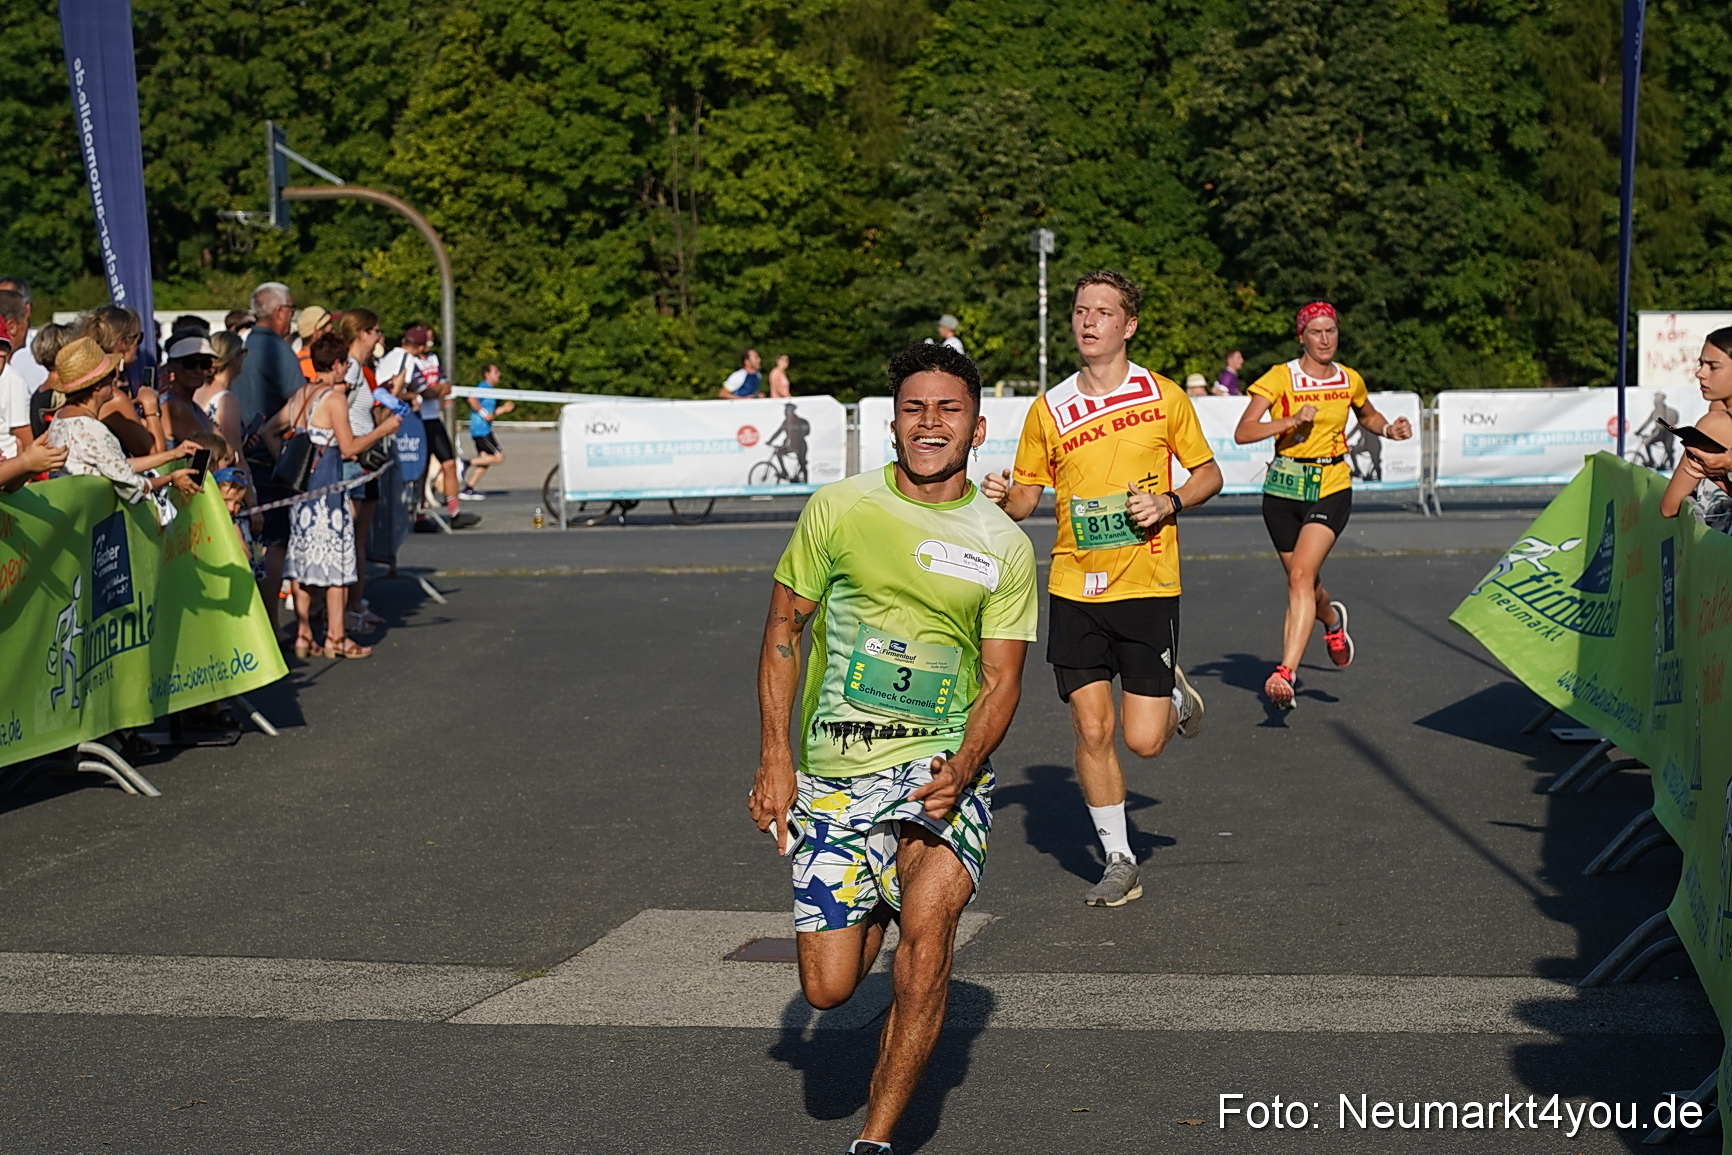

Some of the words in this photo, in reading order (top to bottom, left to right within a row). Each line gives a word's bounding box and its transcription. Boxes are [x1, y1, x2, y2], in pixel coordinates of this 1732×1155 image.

[1294, 393, 1322, 403] MAX
[1324, 391, 1351, 401] BÖGL
[585, 421, 620, 436] NOW
[1462, 413, 1498, 427] NOW
[1063, 424, 1108, 455] MAX
[1112, 407, 1167, 433] BÖGL
[1271, 470, 1294, 487] 816
[1075, 522, 1085, 540] RUN
[1087, 513, 1125, 534] 813
[1090, 534, 1103, 542] Deß
[1104, 531, 1128, 540] Yannik
[963, 552, 991, 567] Klinikum
[1486, 591, 1566, 642] neumarkt
[850, 661, 866, 690] RUN
[892, 666, 913, 693] 3
[858, 683, 898, 701] Schneck
[899, 695, 936, 709] Cornelia
[934, 678, 952, 714] 2022
